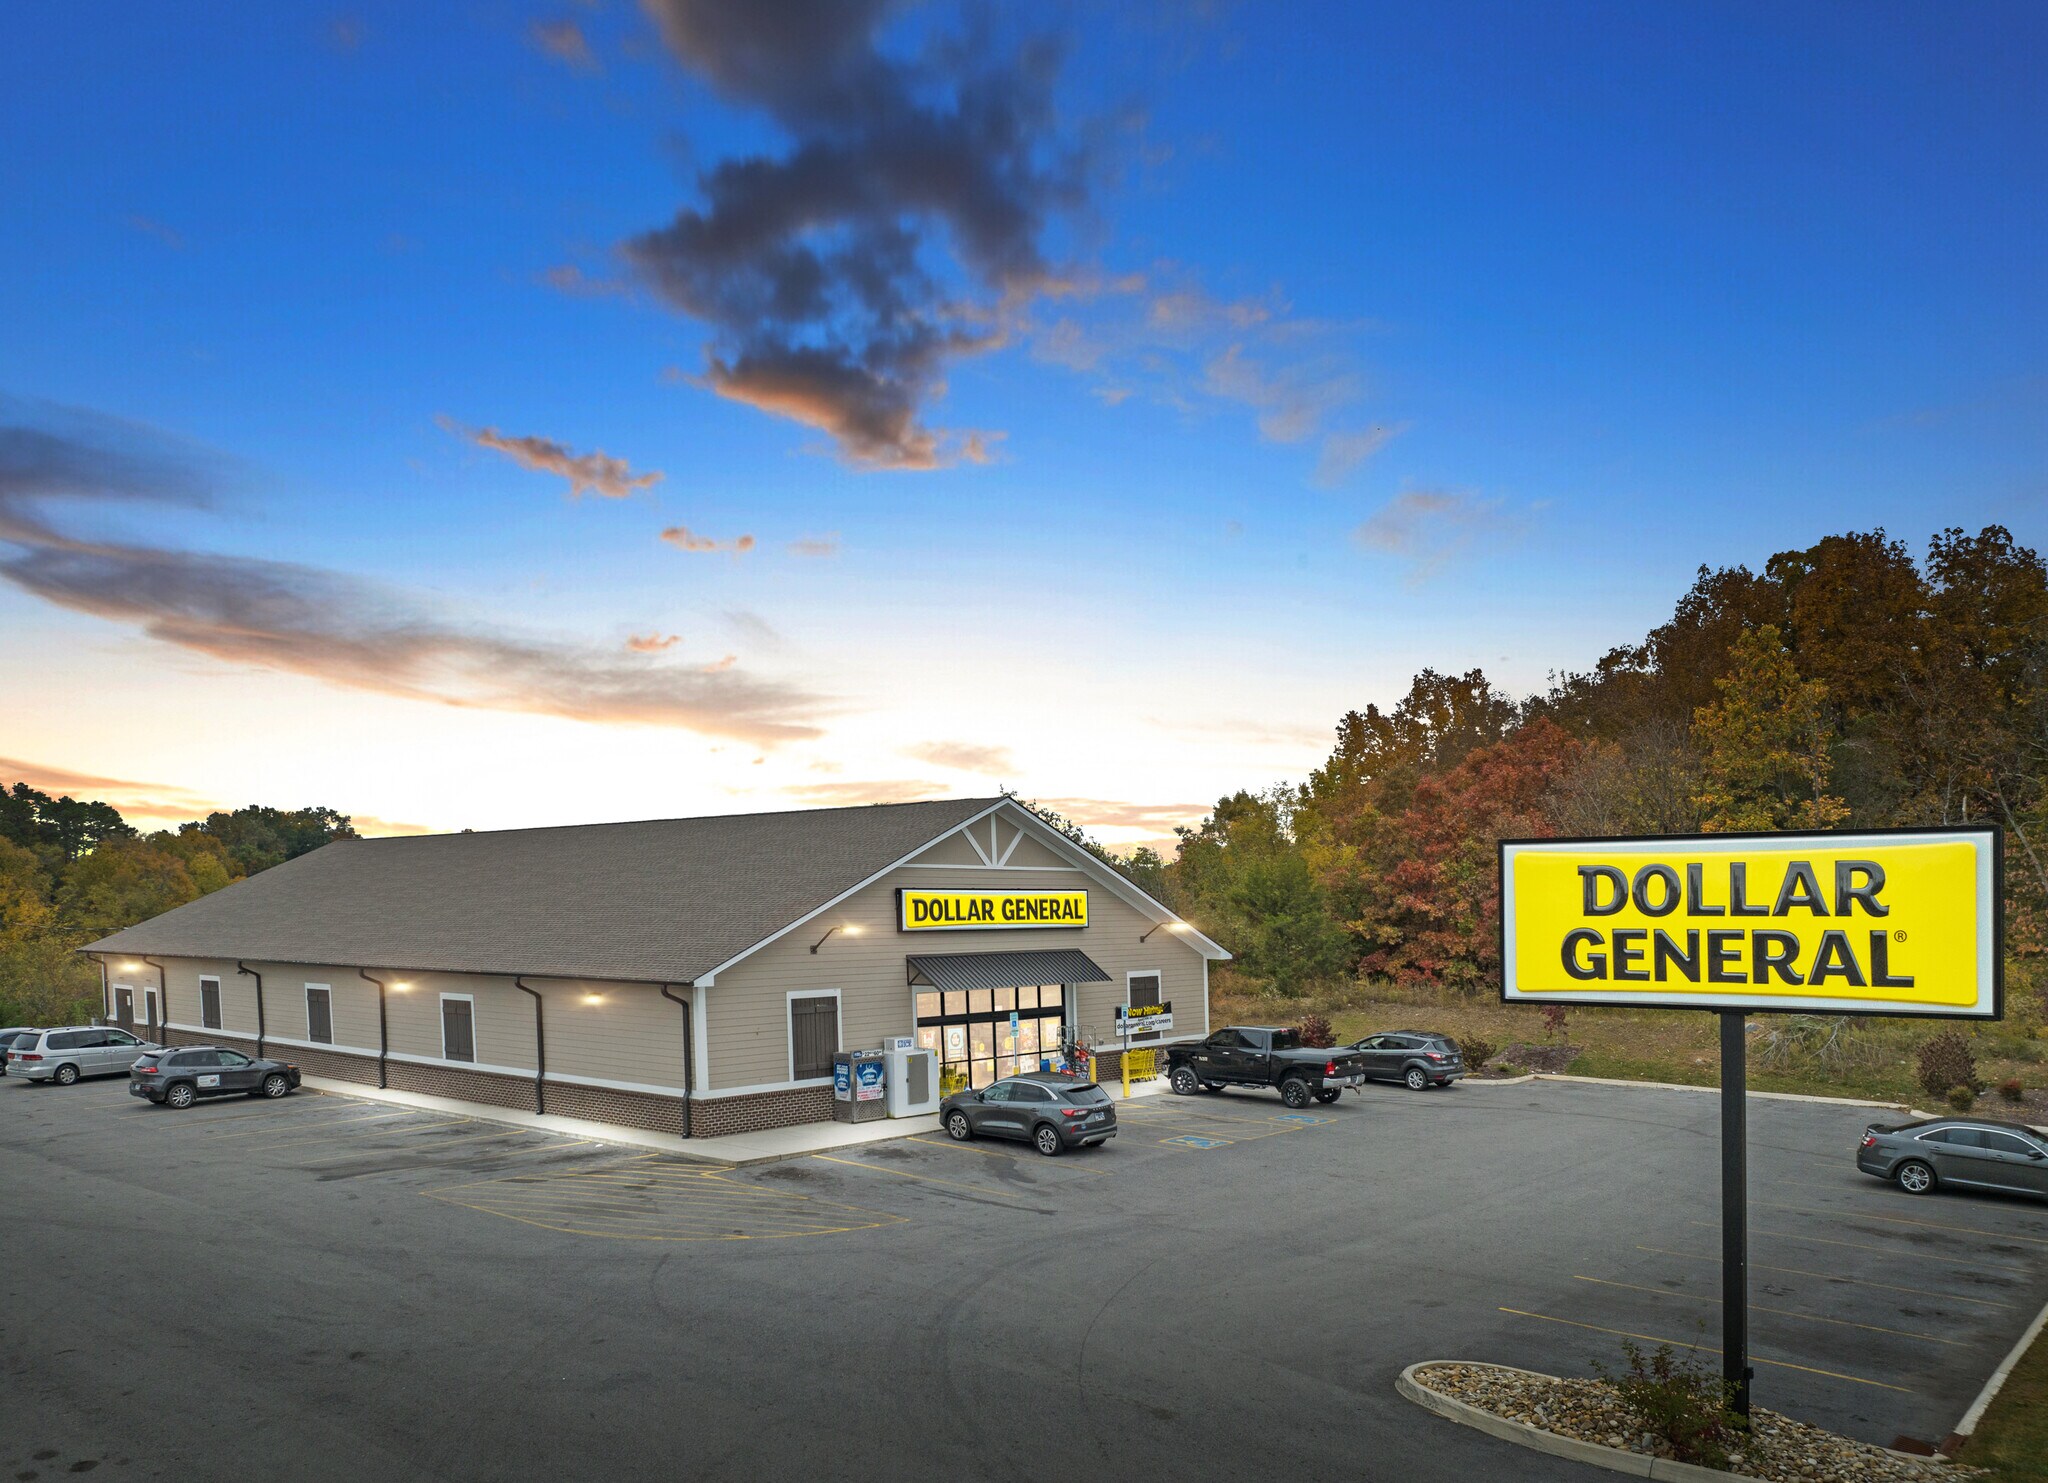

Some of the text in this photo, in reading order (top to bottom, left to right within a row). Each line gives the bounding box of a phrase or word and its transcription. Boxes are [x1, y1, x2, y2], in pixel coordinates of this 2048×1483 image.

[912, 898, 1084, 922] DOLLAR GENERAL
[1577, 860, 1890, 918] DOLLAR
[1560, 927, 1915, 988] GENERAL
